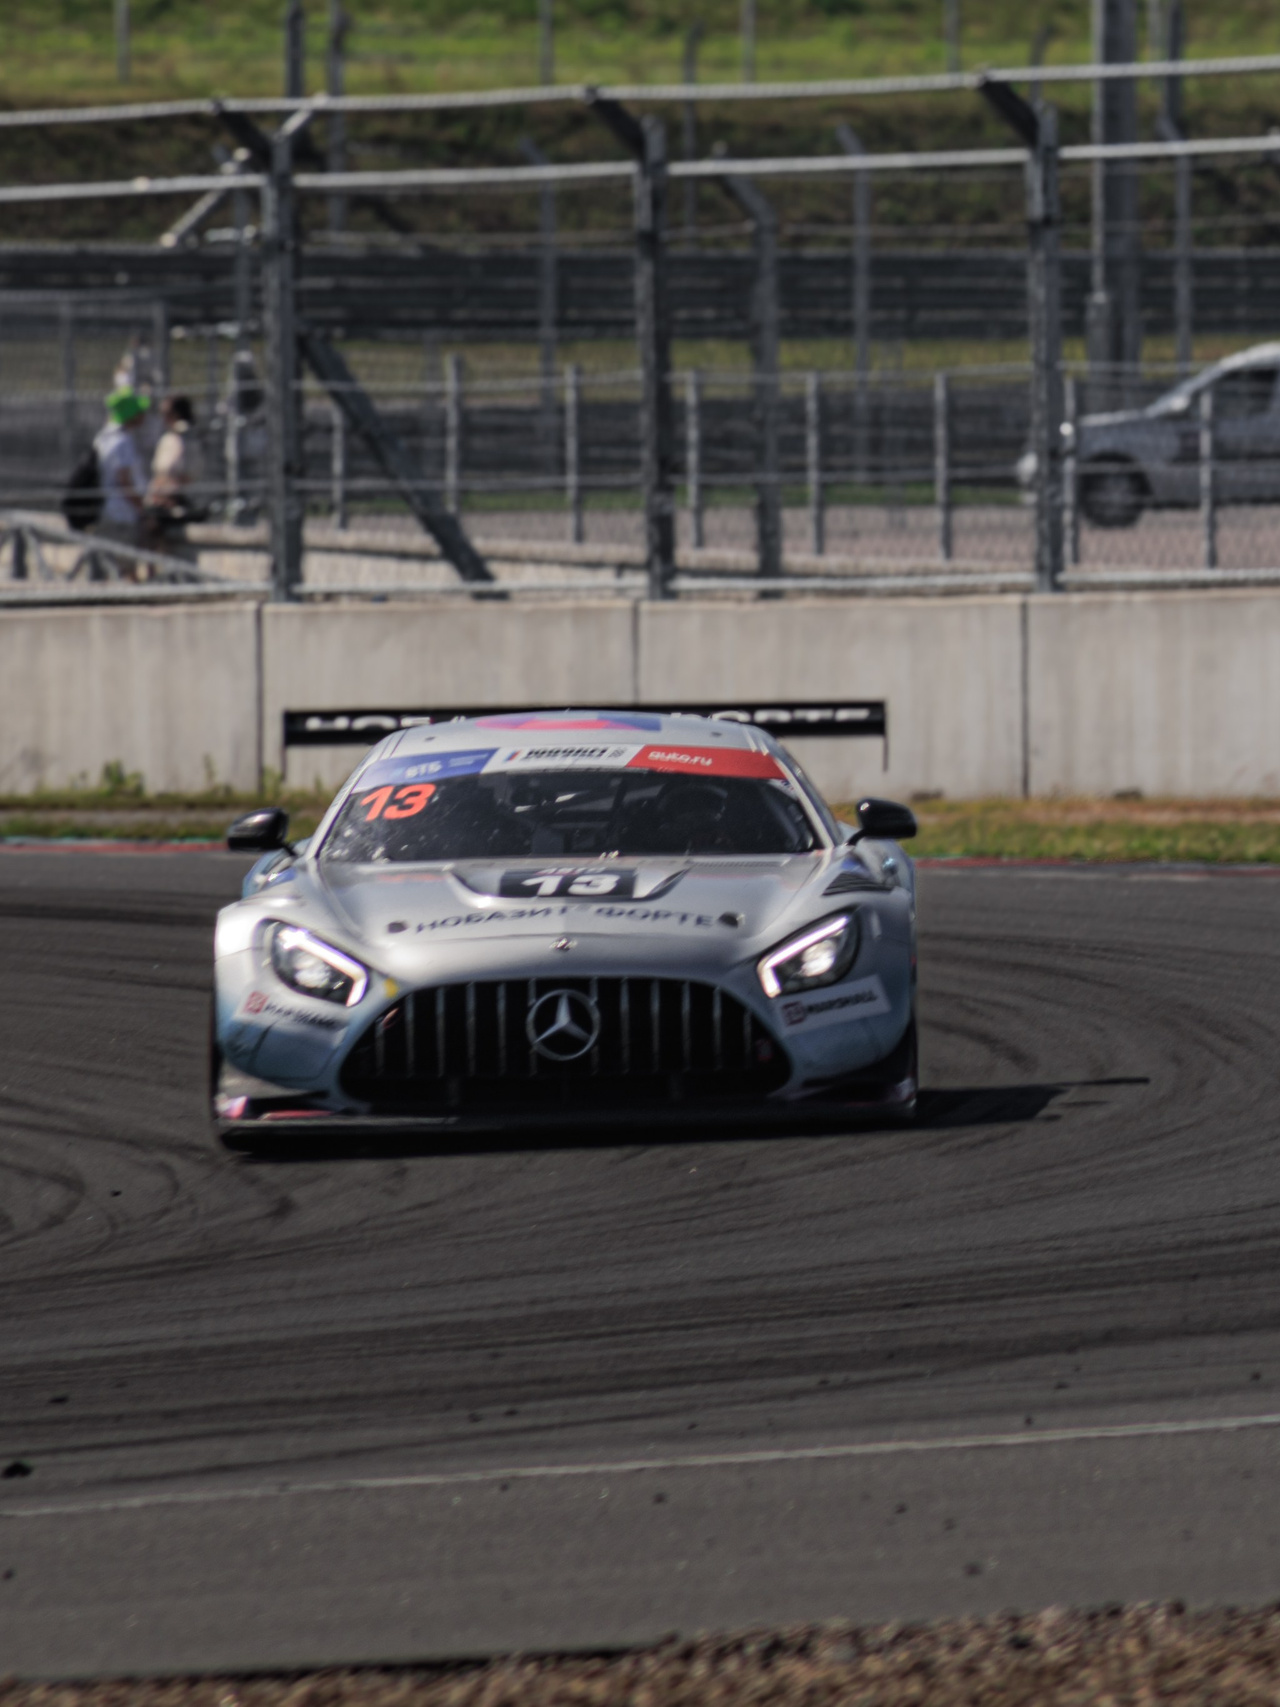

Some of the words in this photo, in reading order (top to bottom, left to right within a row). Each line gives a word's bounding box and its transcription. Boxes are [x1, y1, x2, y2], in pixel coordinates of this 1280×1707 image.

[360, 783, 436, 822] 13
[522, 873, 621, 897] 13
[415, 906, 570, 934] НОБАЗИТ
[596, 906, 714, 928] ФОРТЕ
